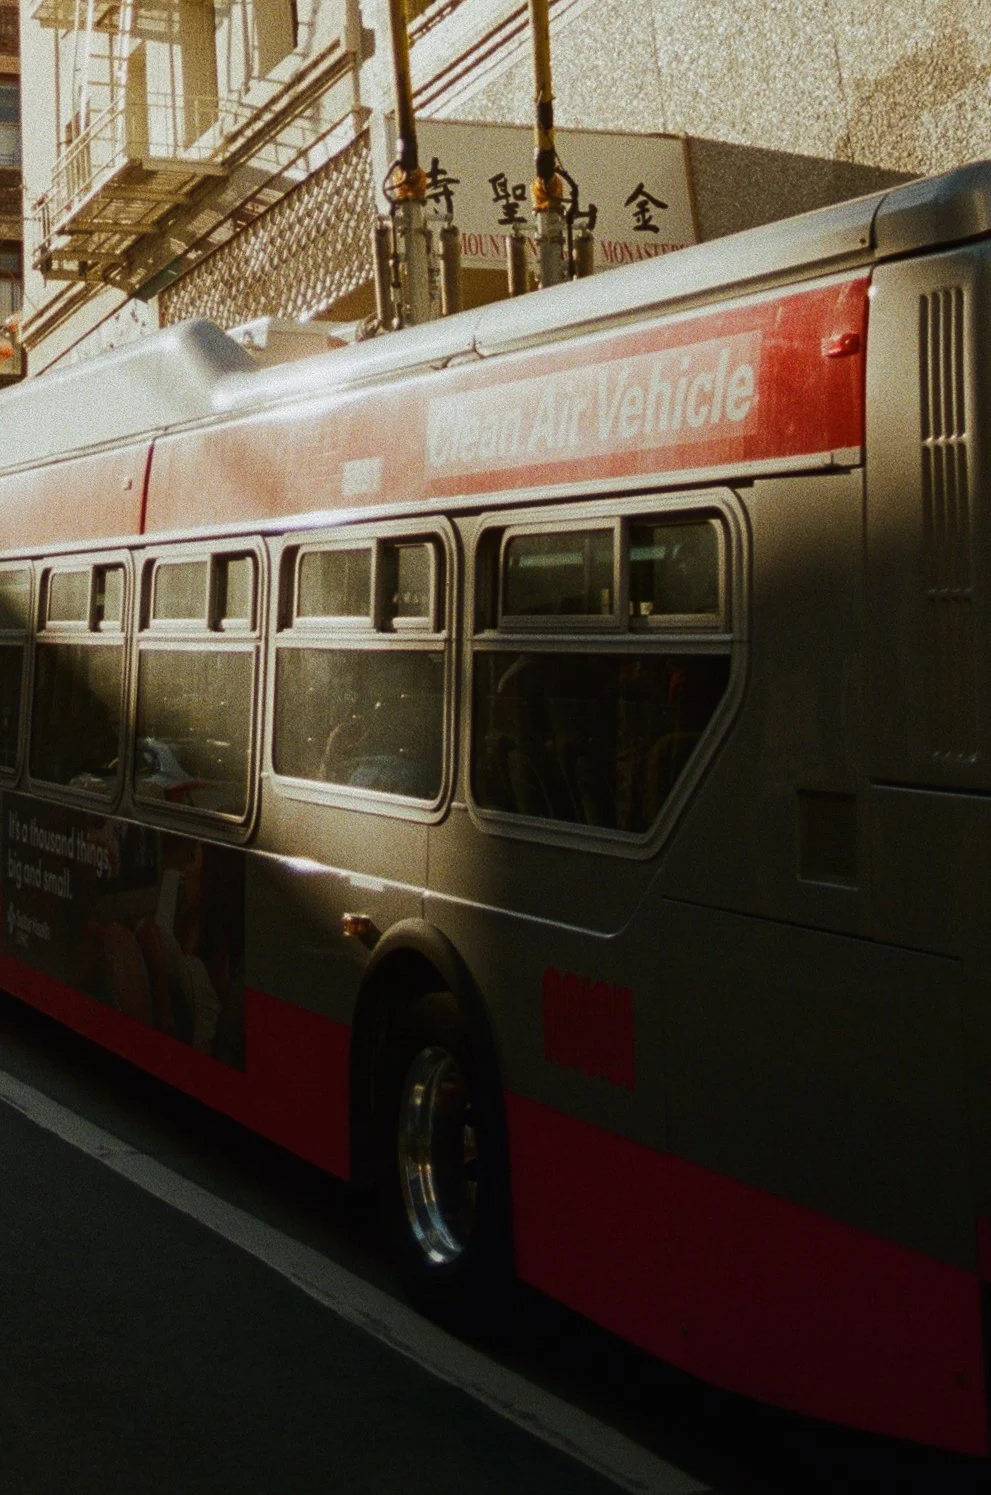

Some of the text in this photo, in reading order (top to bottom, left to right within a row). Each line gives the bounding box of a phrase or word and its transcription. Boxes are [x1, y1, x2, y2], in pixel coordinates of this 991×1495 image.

[459, 232, 539, 260] MOUNTN
[427, 348, 758, 467] Clean Air Vehicle
[30, 816, 75, 859] thousand
[8, 847, 22, 889] big
[23, 859, 42, 888] and
